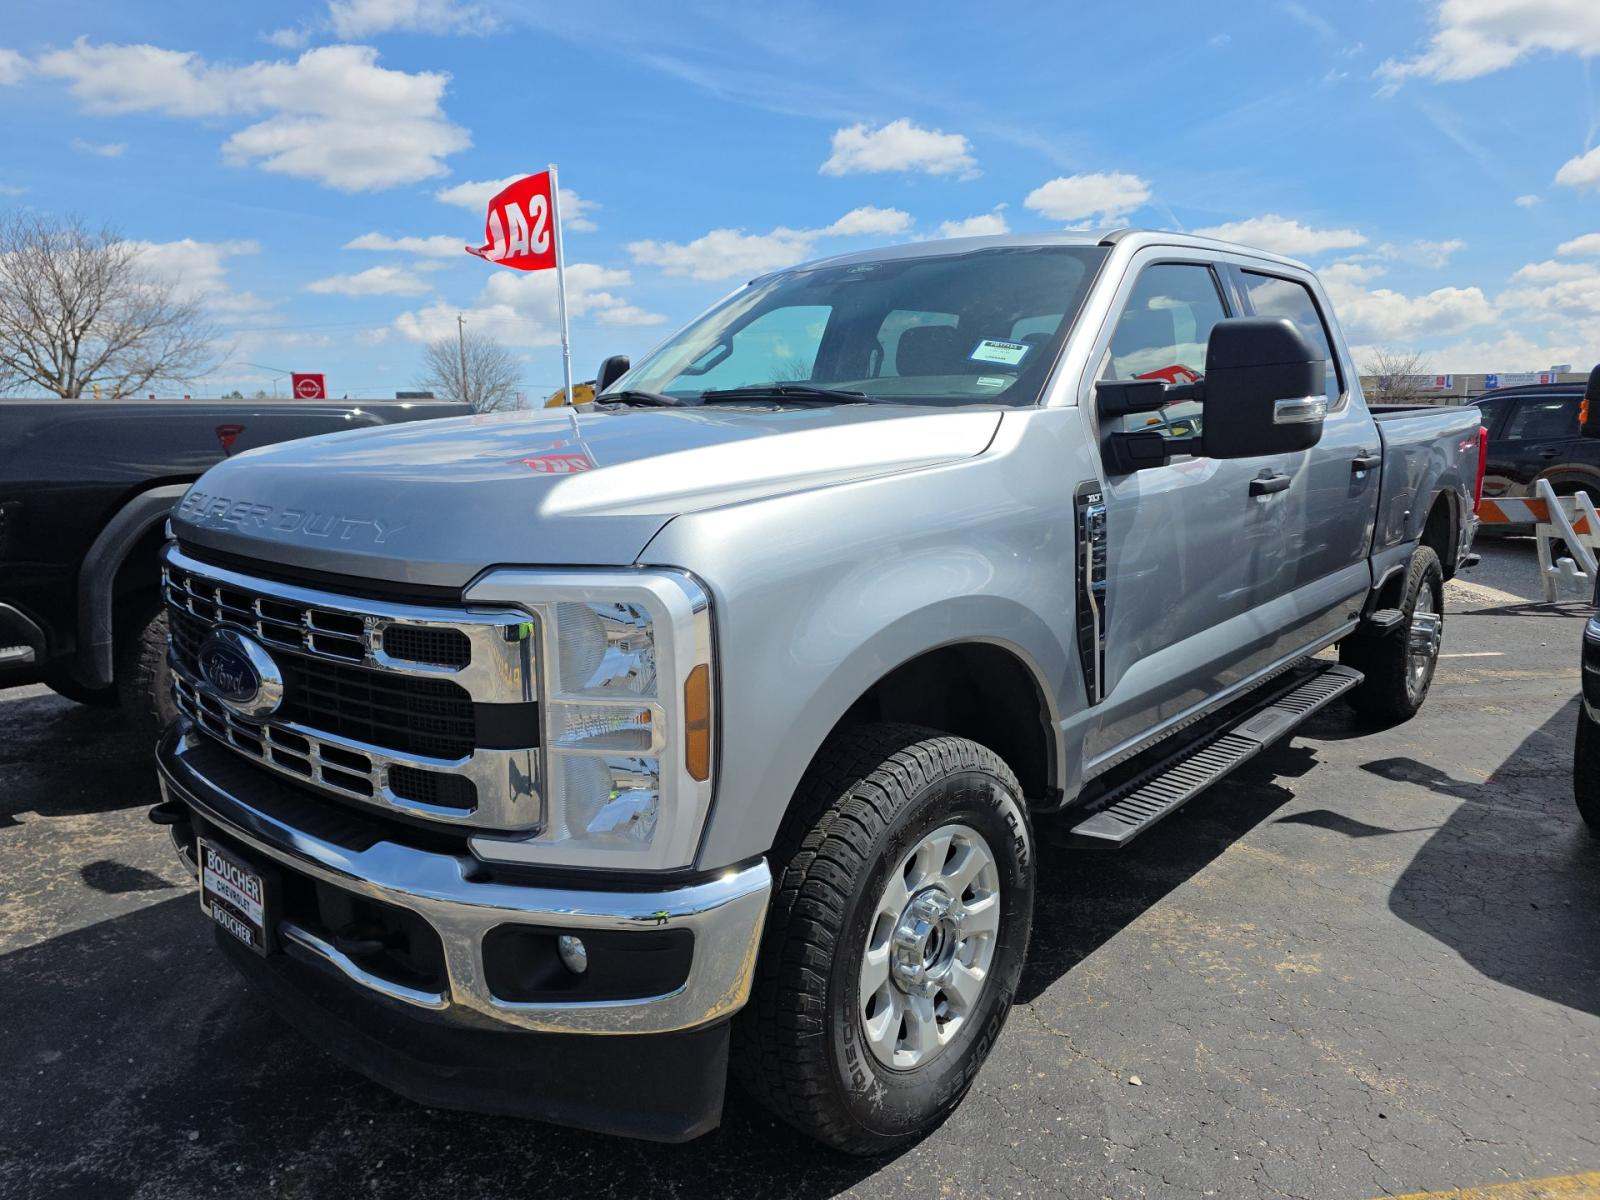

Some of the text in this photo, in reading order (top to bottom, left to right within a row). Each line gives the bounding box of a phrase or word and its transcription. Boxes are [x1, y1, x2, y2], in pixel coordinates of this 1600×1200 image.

[179, 491, 408, 543] SUPER DUTY
[1086, 493, 1102, 503] XLT
[207, 849, 260, 902] BOUCHER
[216, 880, 250, 912] CHEVROLET
[213, 903, 252, 945] BOUCHER
